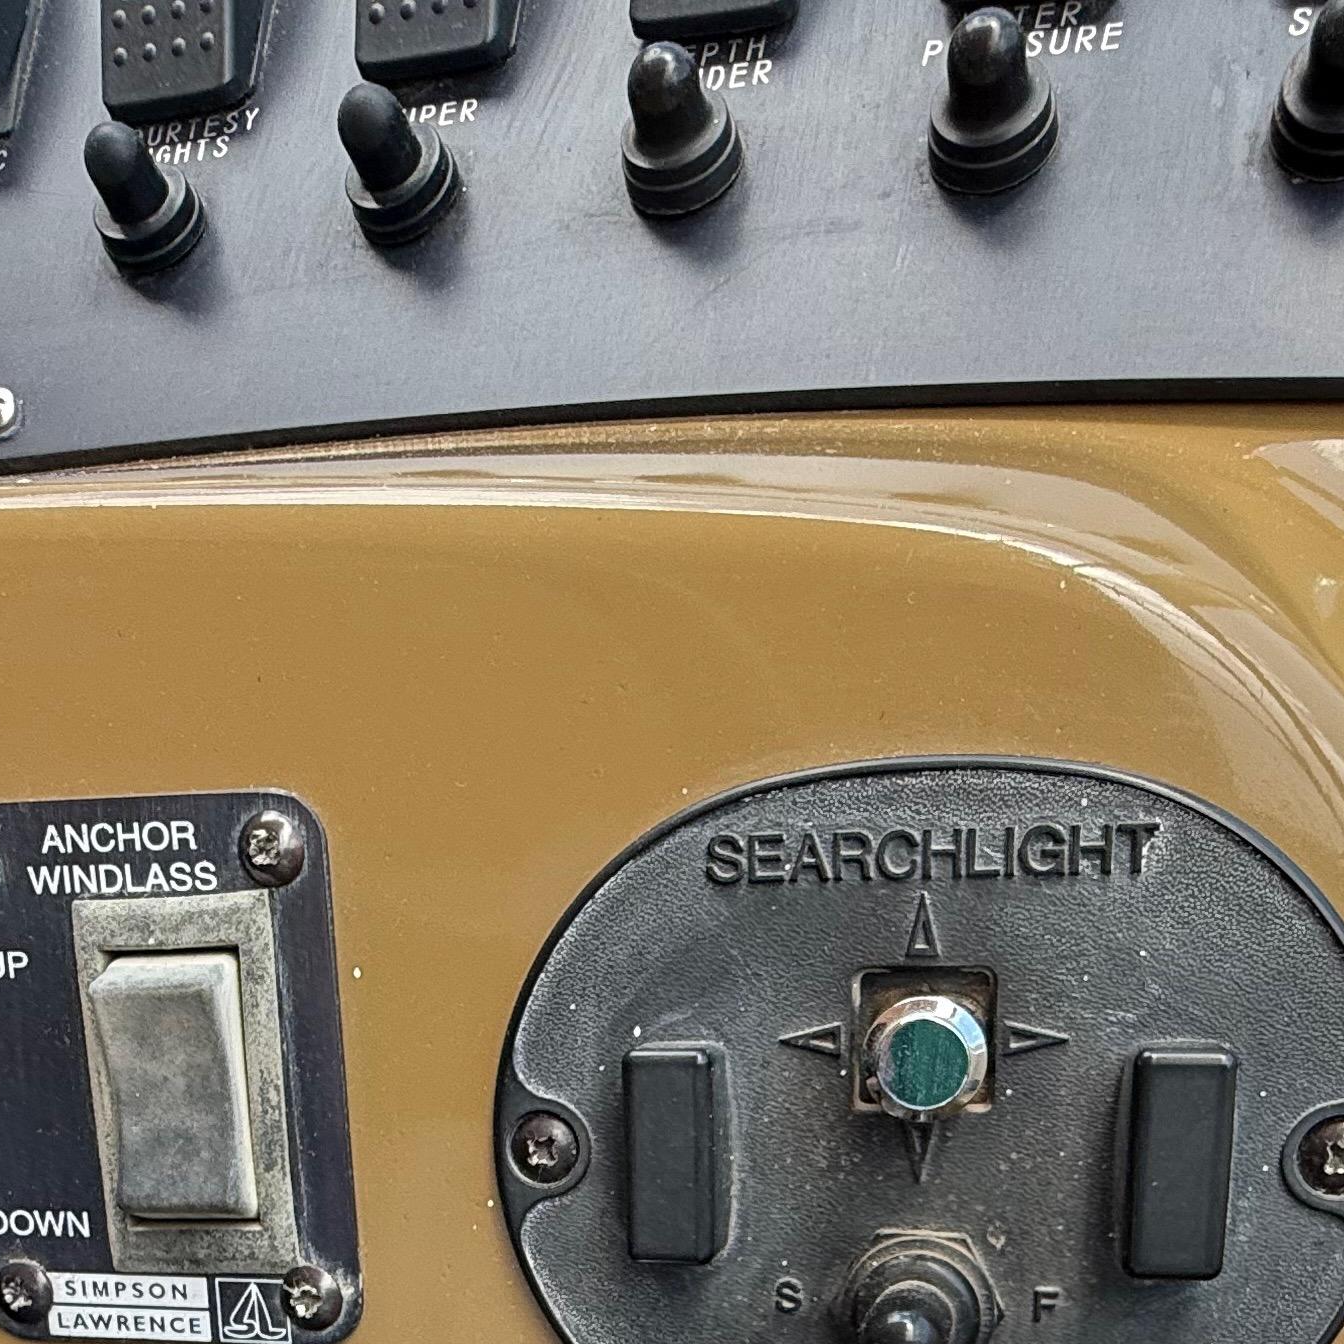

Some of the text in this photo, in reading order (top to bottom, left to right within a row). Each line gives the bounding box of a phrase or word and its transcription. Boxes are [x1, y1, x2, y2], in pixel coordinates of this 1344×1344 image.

[402, 98, 478, 126] IPER
[41, 821, 197, 855] ANCHOR
[705, 819, 1163, 884] SEARCHLIGHT
[27, 860, 218, 895] WINDLASS
[64, 1279, 189, 1301] SIMPSON
[773, 1277, 805, 1315] S
[1031, 1286, 1061, 1324] F
[57, 1310, 203, 1335] LAWRENCE
